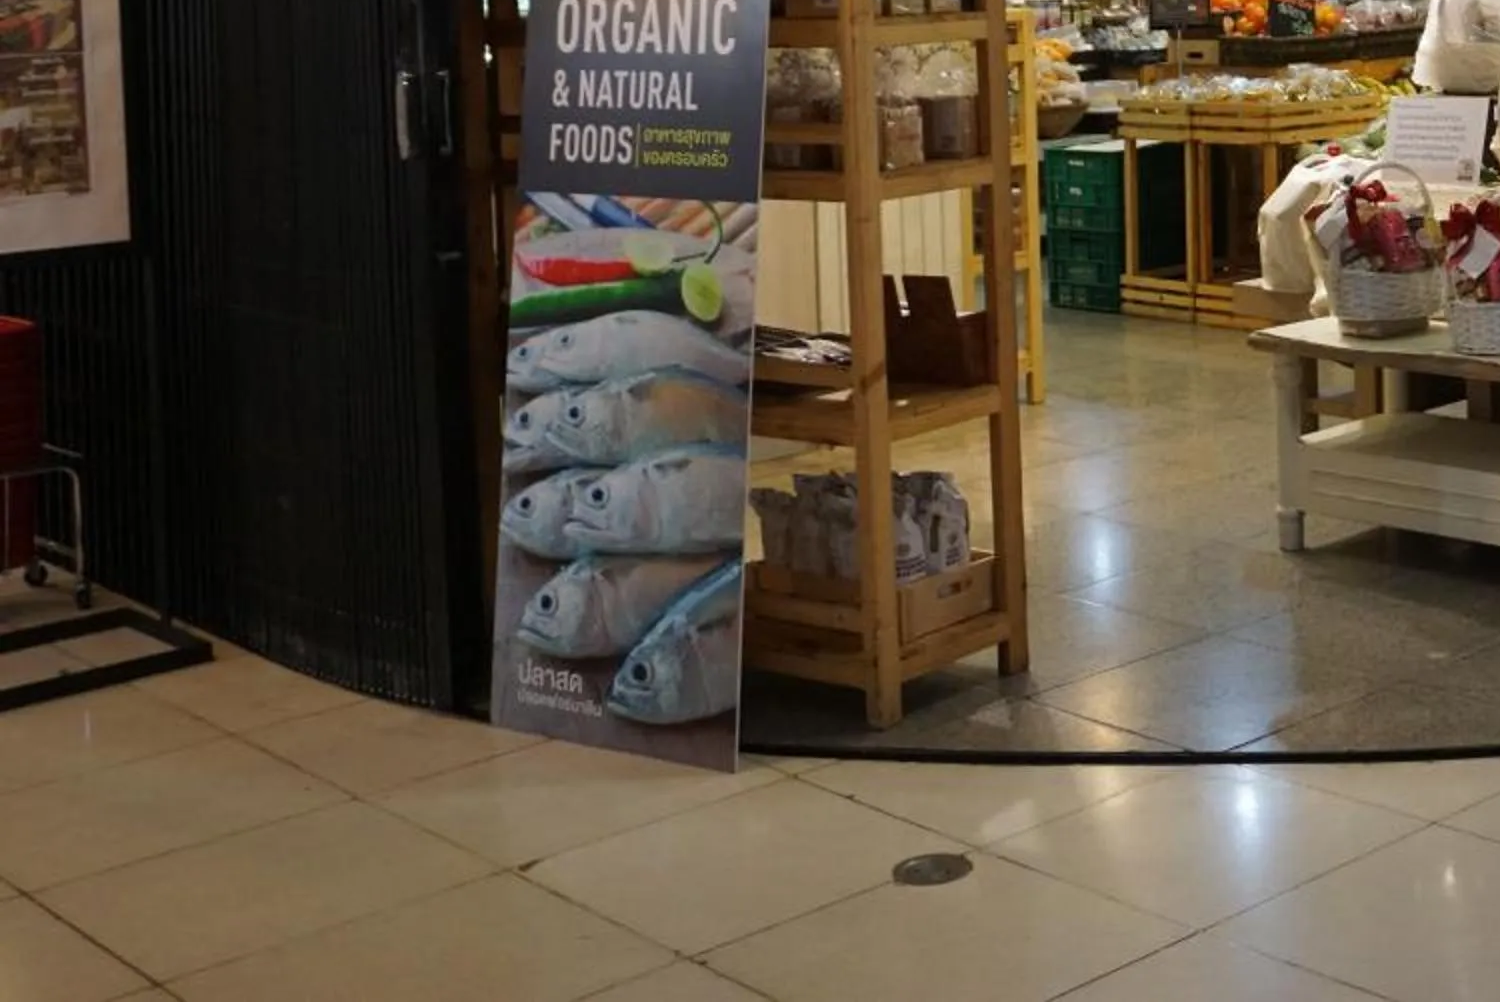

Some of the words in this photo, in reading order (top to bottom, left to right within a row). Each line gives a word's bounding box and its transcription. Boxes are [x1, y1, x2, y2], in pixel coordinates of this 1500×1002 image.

[552, 69, 571, 108] &
[578, 69, 699, 111] NATURAL
[549, 123, 634, 166] FOODS
[643, 128, 732, 149] อาหารสุขภาพ
[643, 149, 729, 168] ของครอบครัว
[518, 657, 583, 694] ปลาสด
